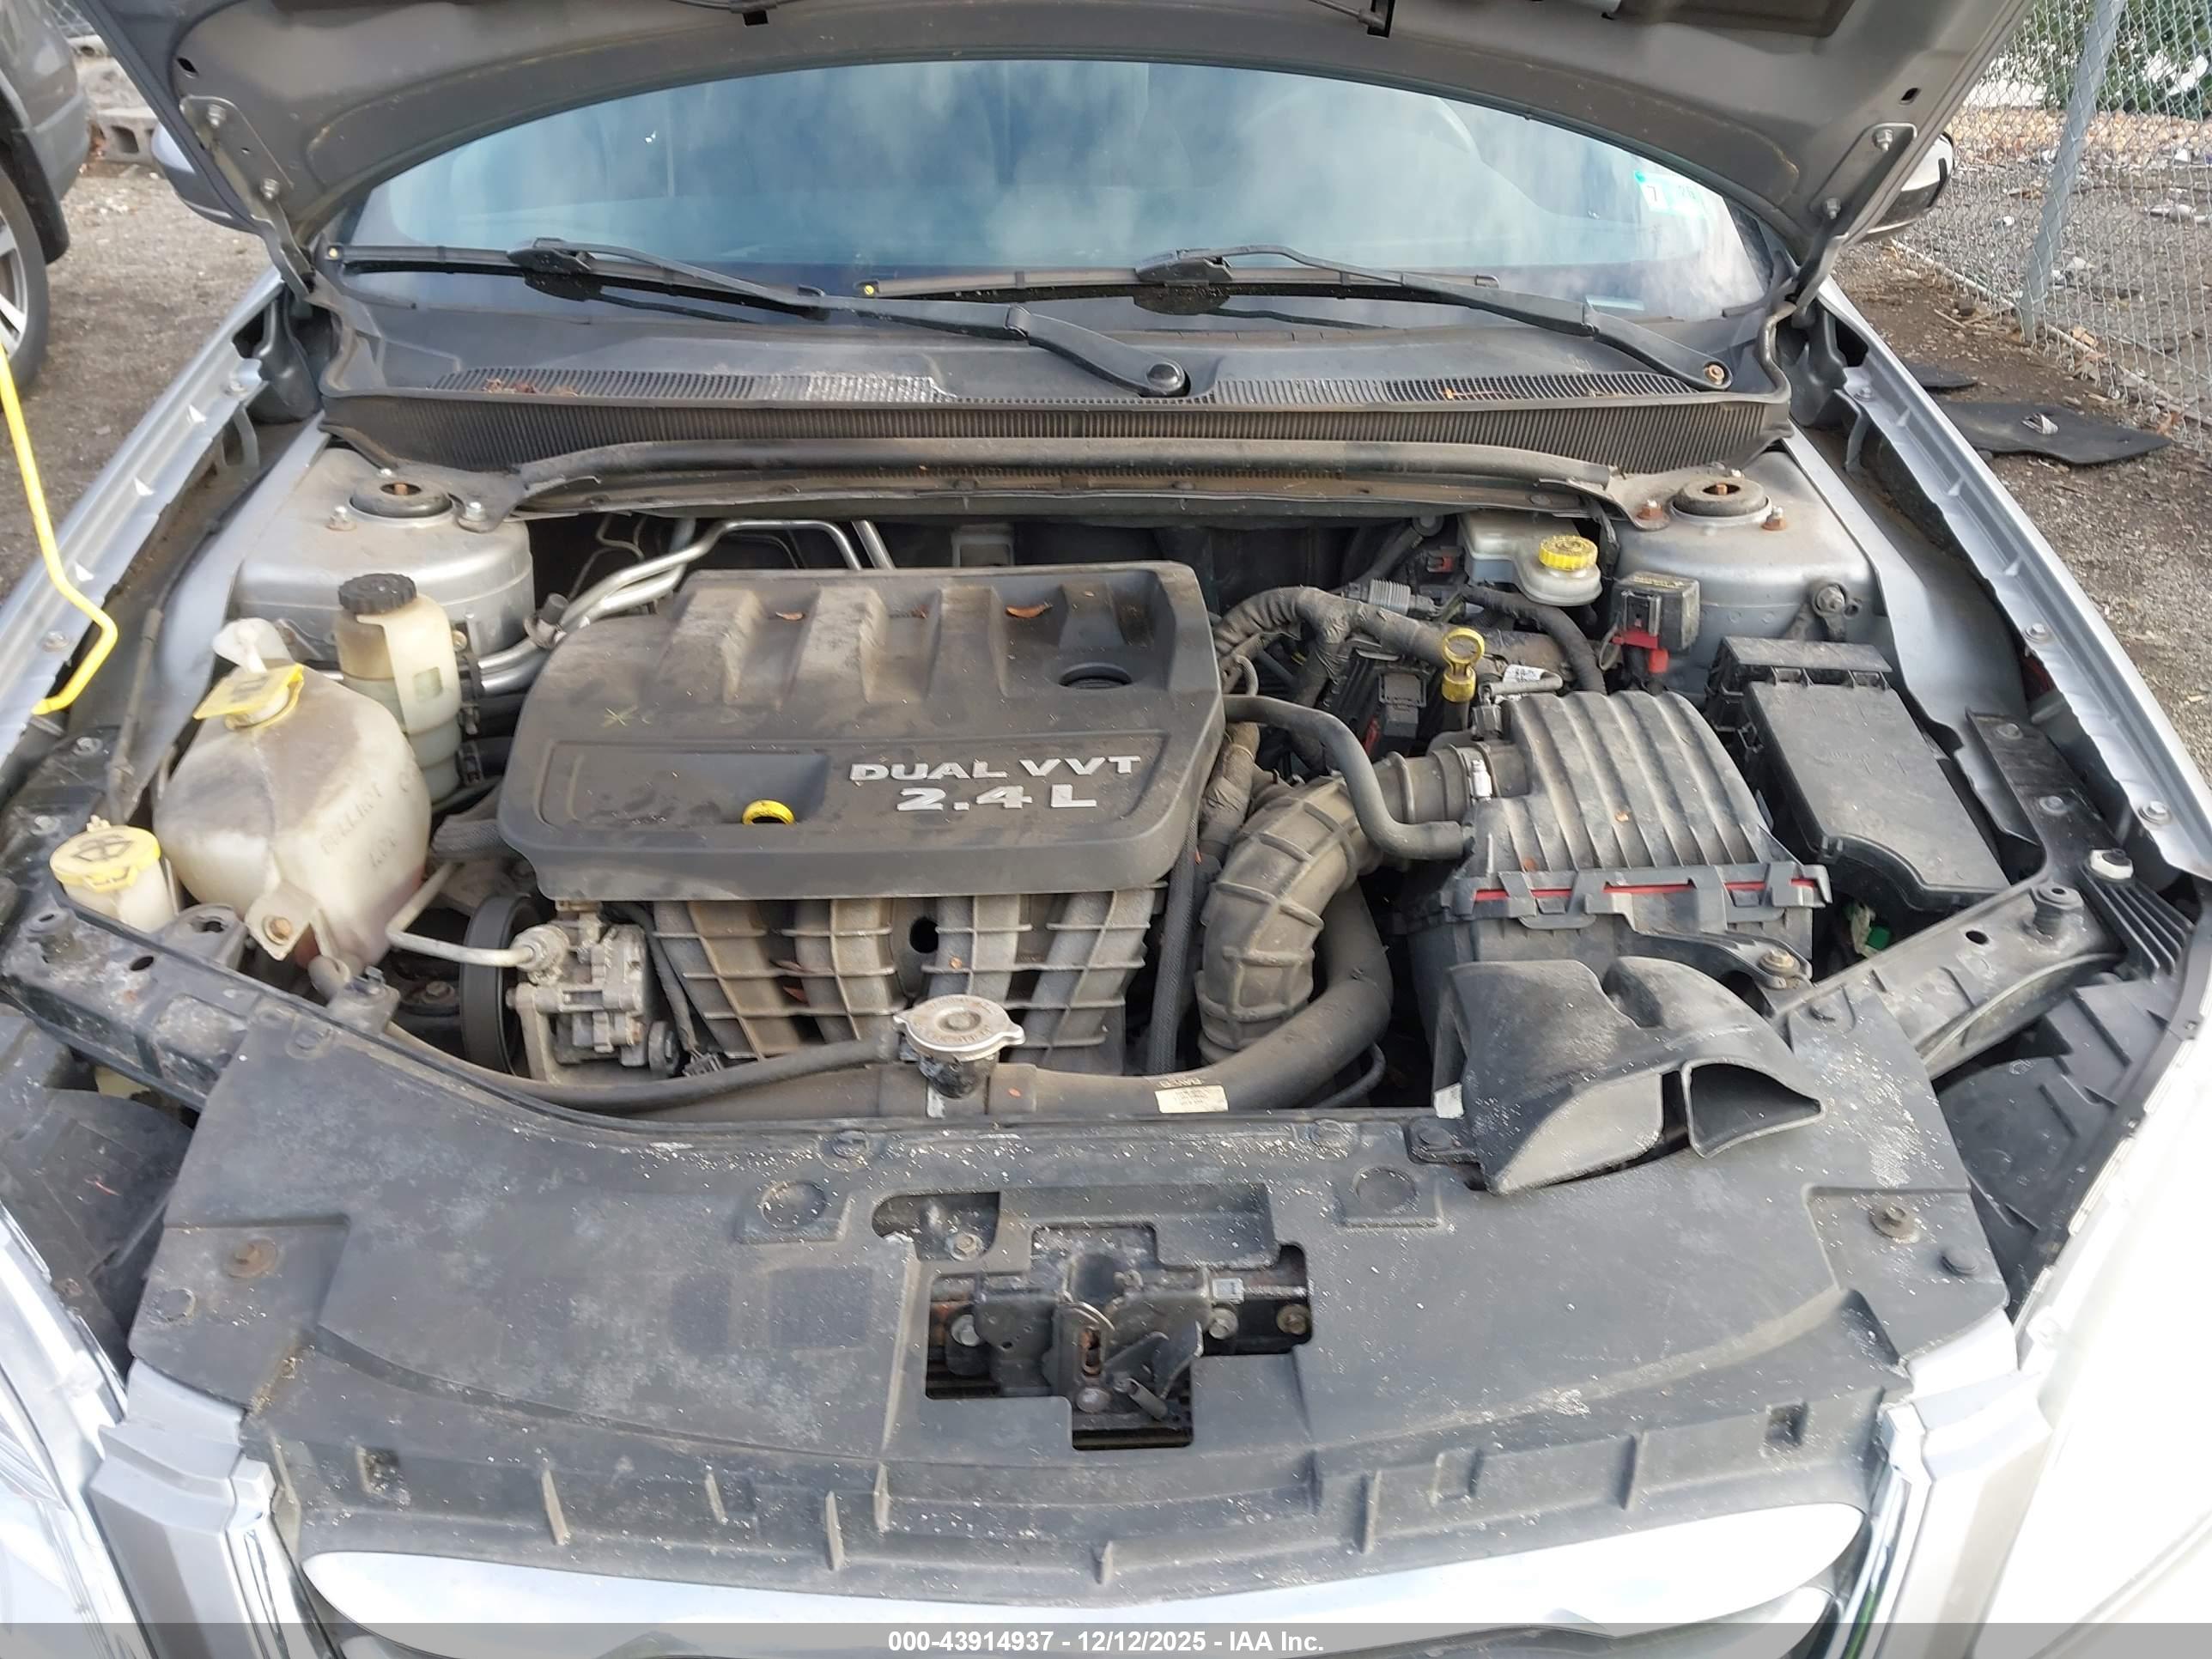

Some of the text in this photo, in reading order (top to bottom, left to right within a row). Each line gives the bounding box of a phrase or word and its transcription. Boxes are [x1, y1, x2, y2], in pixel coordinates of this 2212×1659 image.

[850, 756, 1141, 781] DUAL VVT
[896, 784, 1097, 811] 2.4 L
